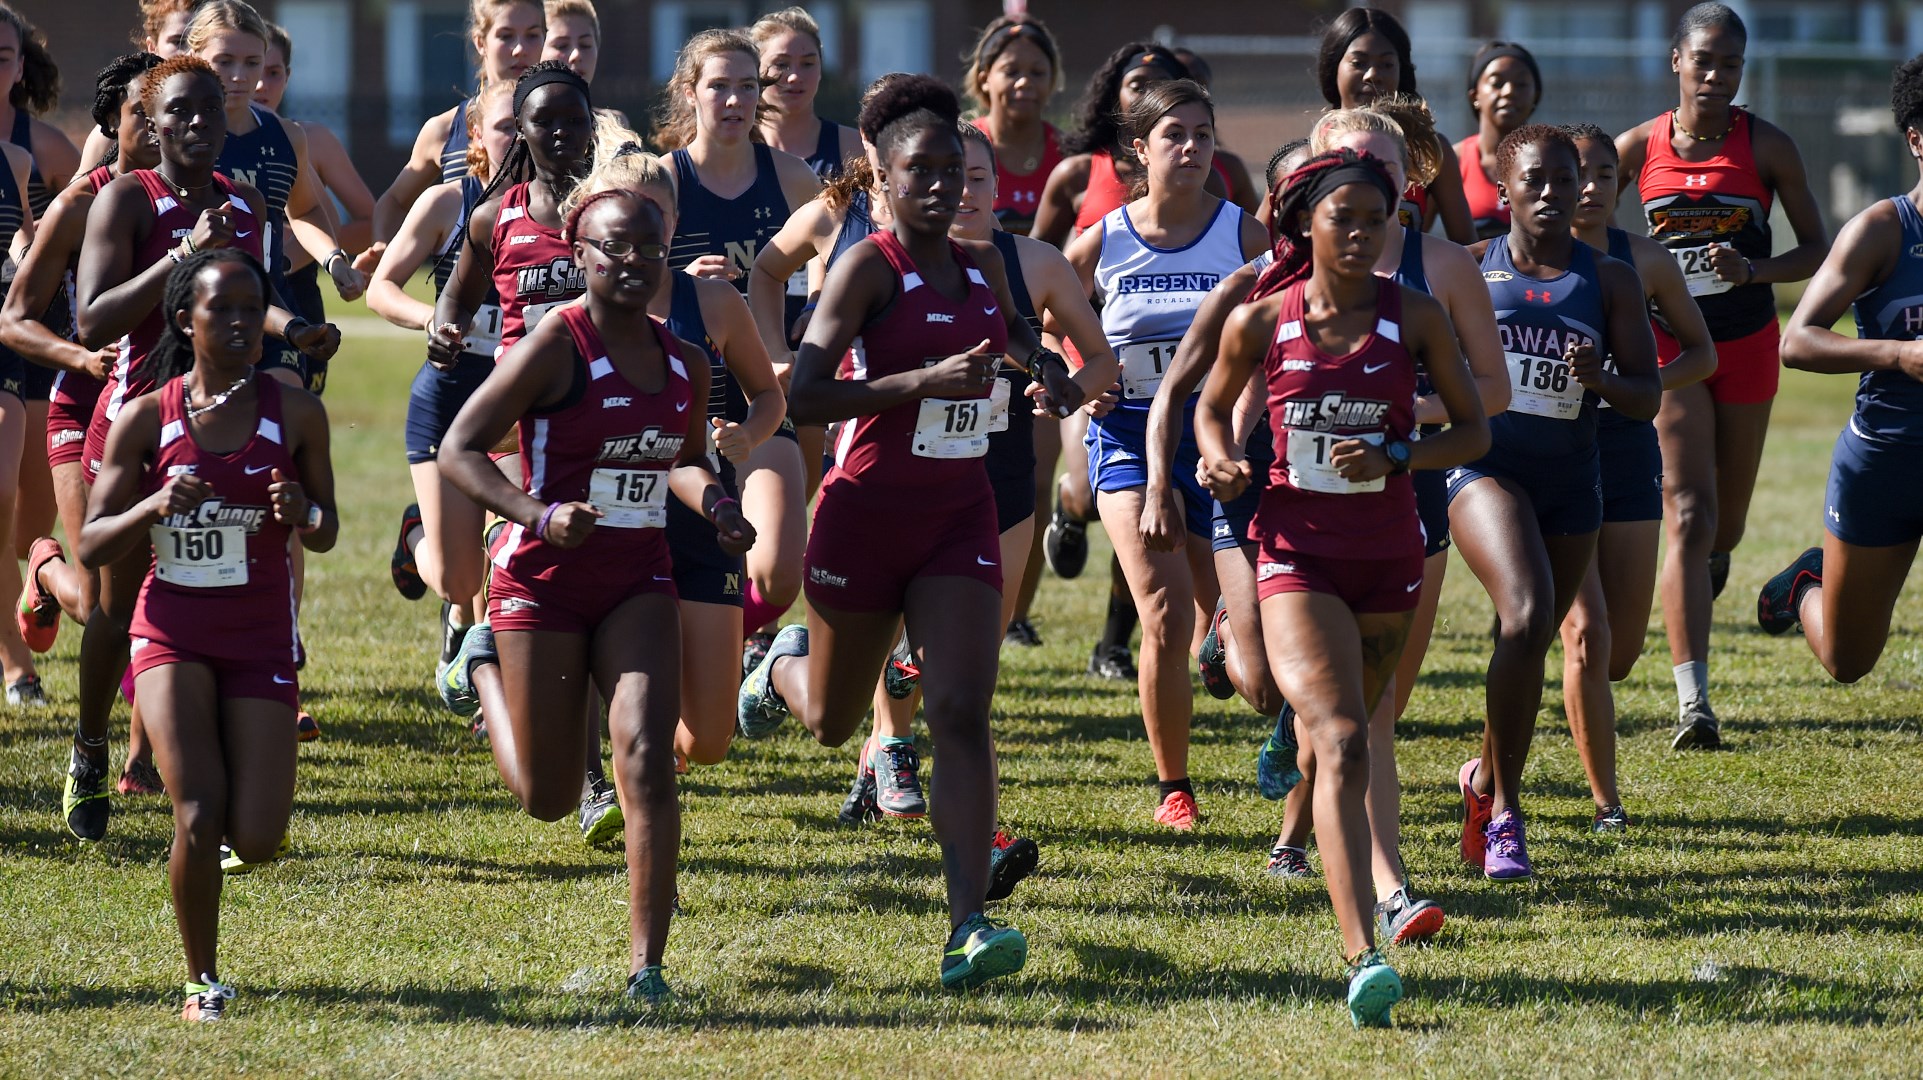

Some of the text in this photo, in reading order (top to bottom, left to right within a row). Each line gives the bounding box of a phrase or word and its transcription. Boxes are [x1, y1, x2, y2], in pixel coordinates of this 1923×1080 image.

[1669, 209, 1711, 217] UNIVERSITY
[172, 228, 193, 239] MEA
[510, 235, 538, 245] MEAC
[1673, 247, 1716, 275] 23
[517, 259, 587, 297] THE SHO
[1120, 274, 1218, 293] REGENT
[1484, 270, 1512, 280] MEAC
[1147, 297, 1191, 305] ROYALS
[926, 313, 954, 323] MEAC
[1499, 324, 1595, 357] OWAR
[1519, 357, 1570, 393] 136
[603, 397, 631, 408] MEAC
[944, 402, 978, 433] 151
[1284, 394, 1388, 433] THE SHORE
[600, 438, 638, 460] THE
[615, 473, 657, 503] 157
[170, 530, 223, 561] 150
[724, 573, 739, 589] N
